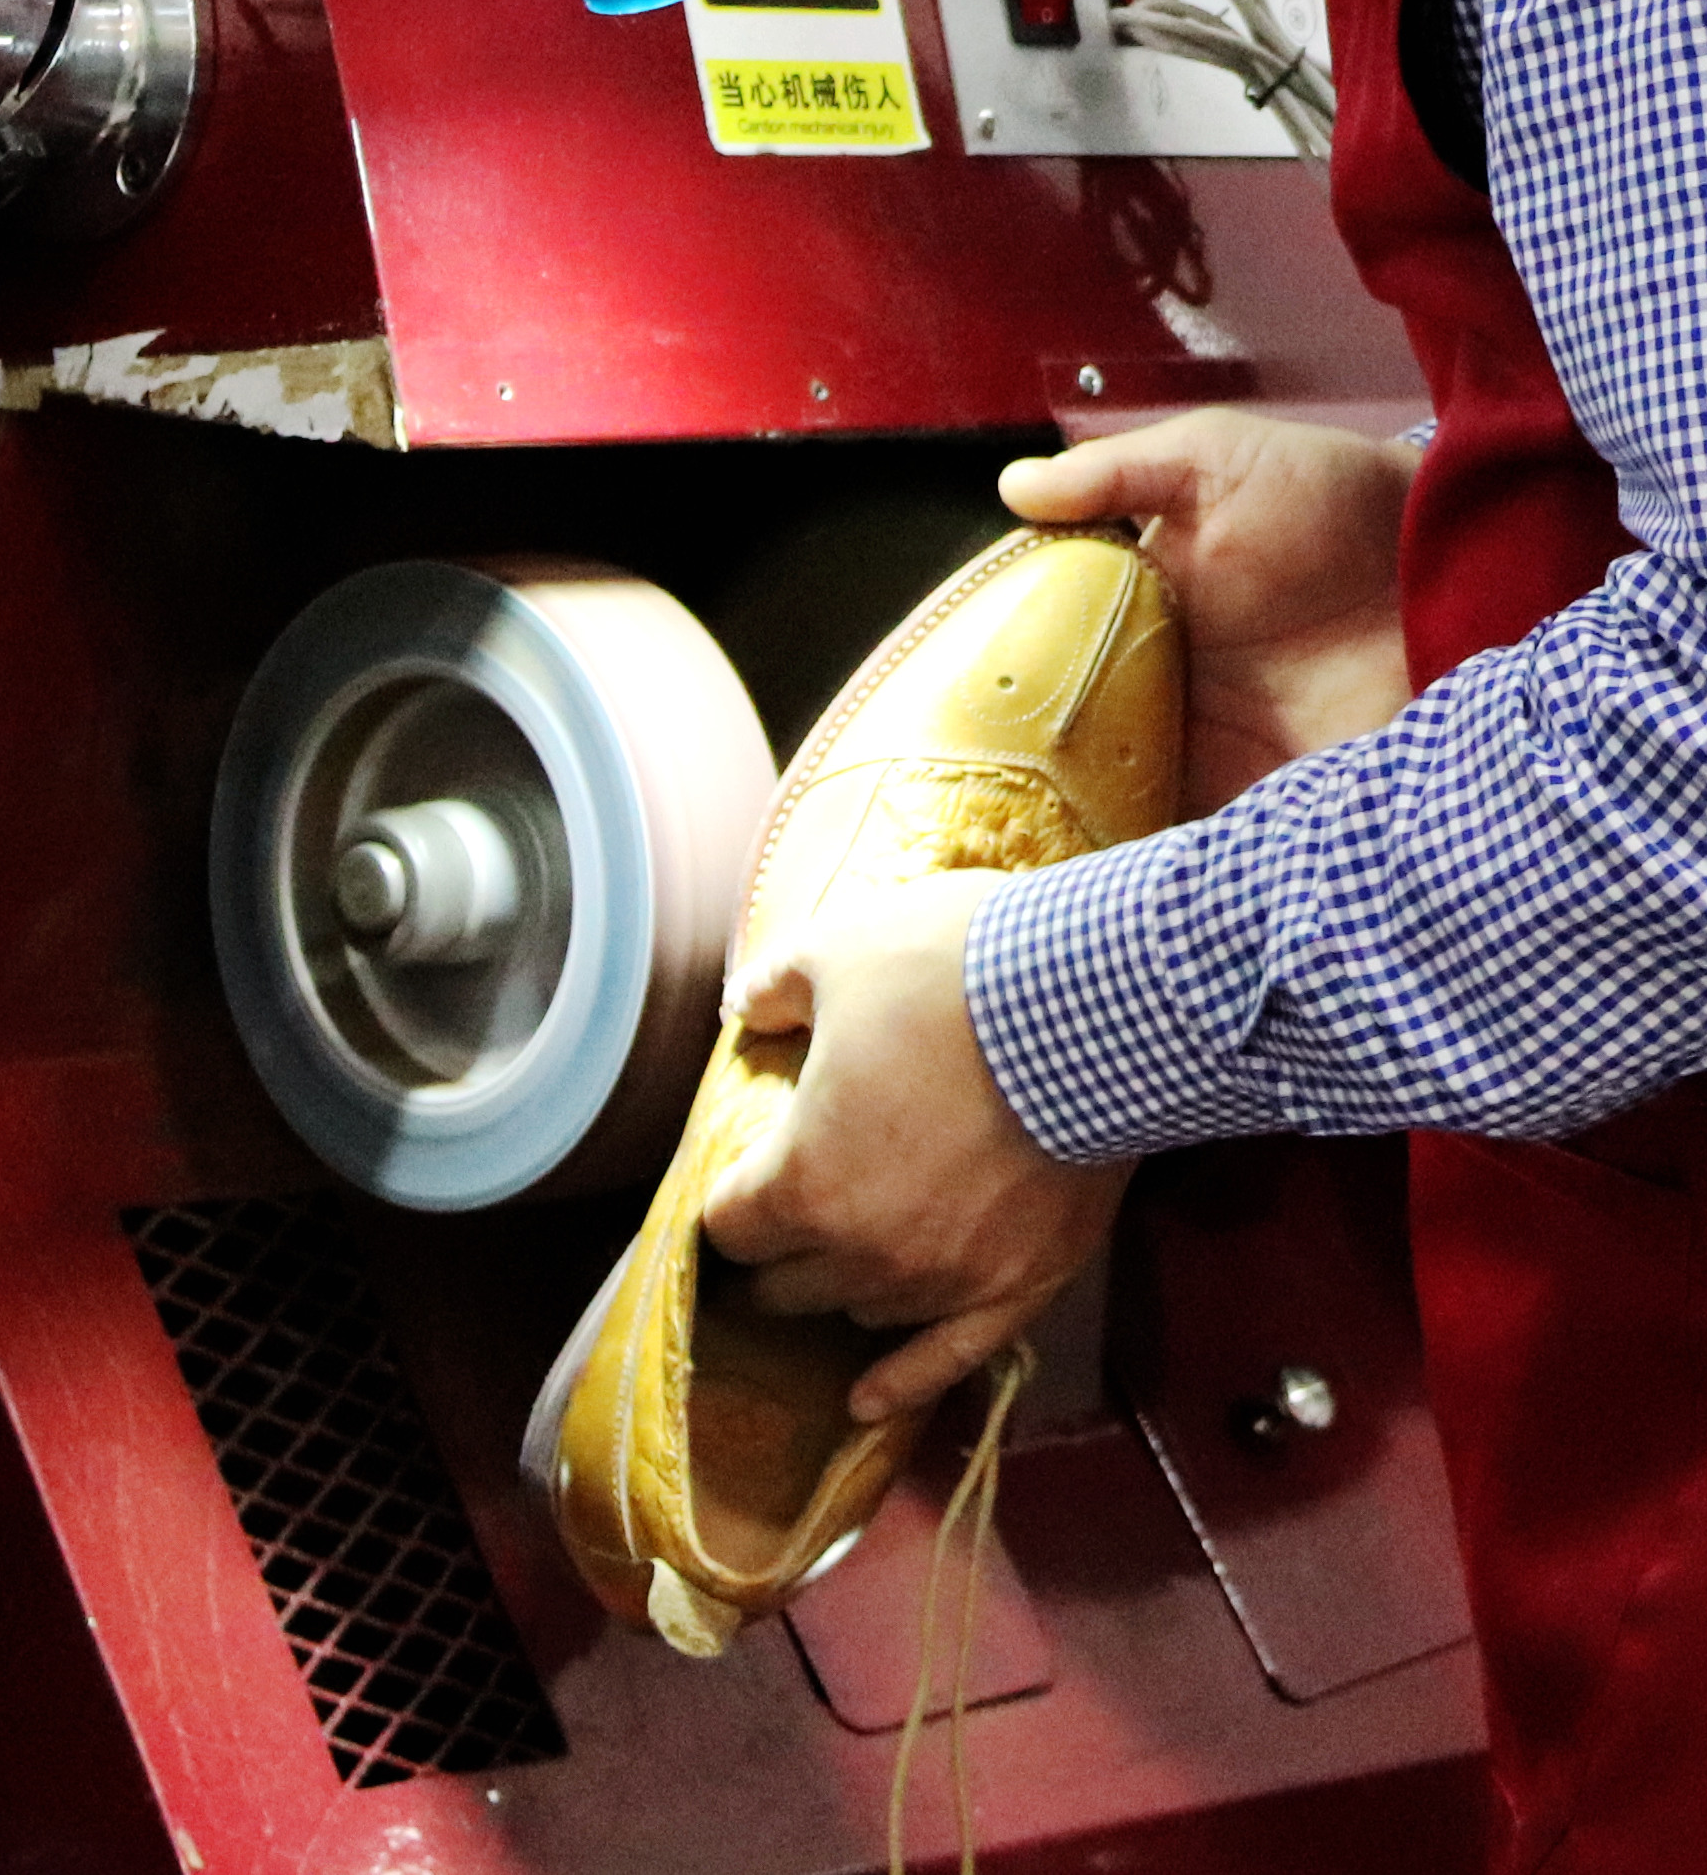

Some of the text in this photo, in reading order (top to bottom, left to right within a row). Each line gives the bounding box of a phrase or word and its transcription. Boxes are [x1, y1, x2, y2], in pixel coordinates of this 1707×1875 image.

[718, 70, 901, 110] 当心机械伤人
[789, 119, 859, 135] mechanical
[861, 120, 895, 139] injury
